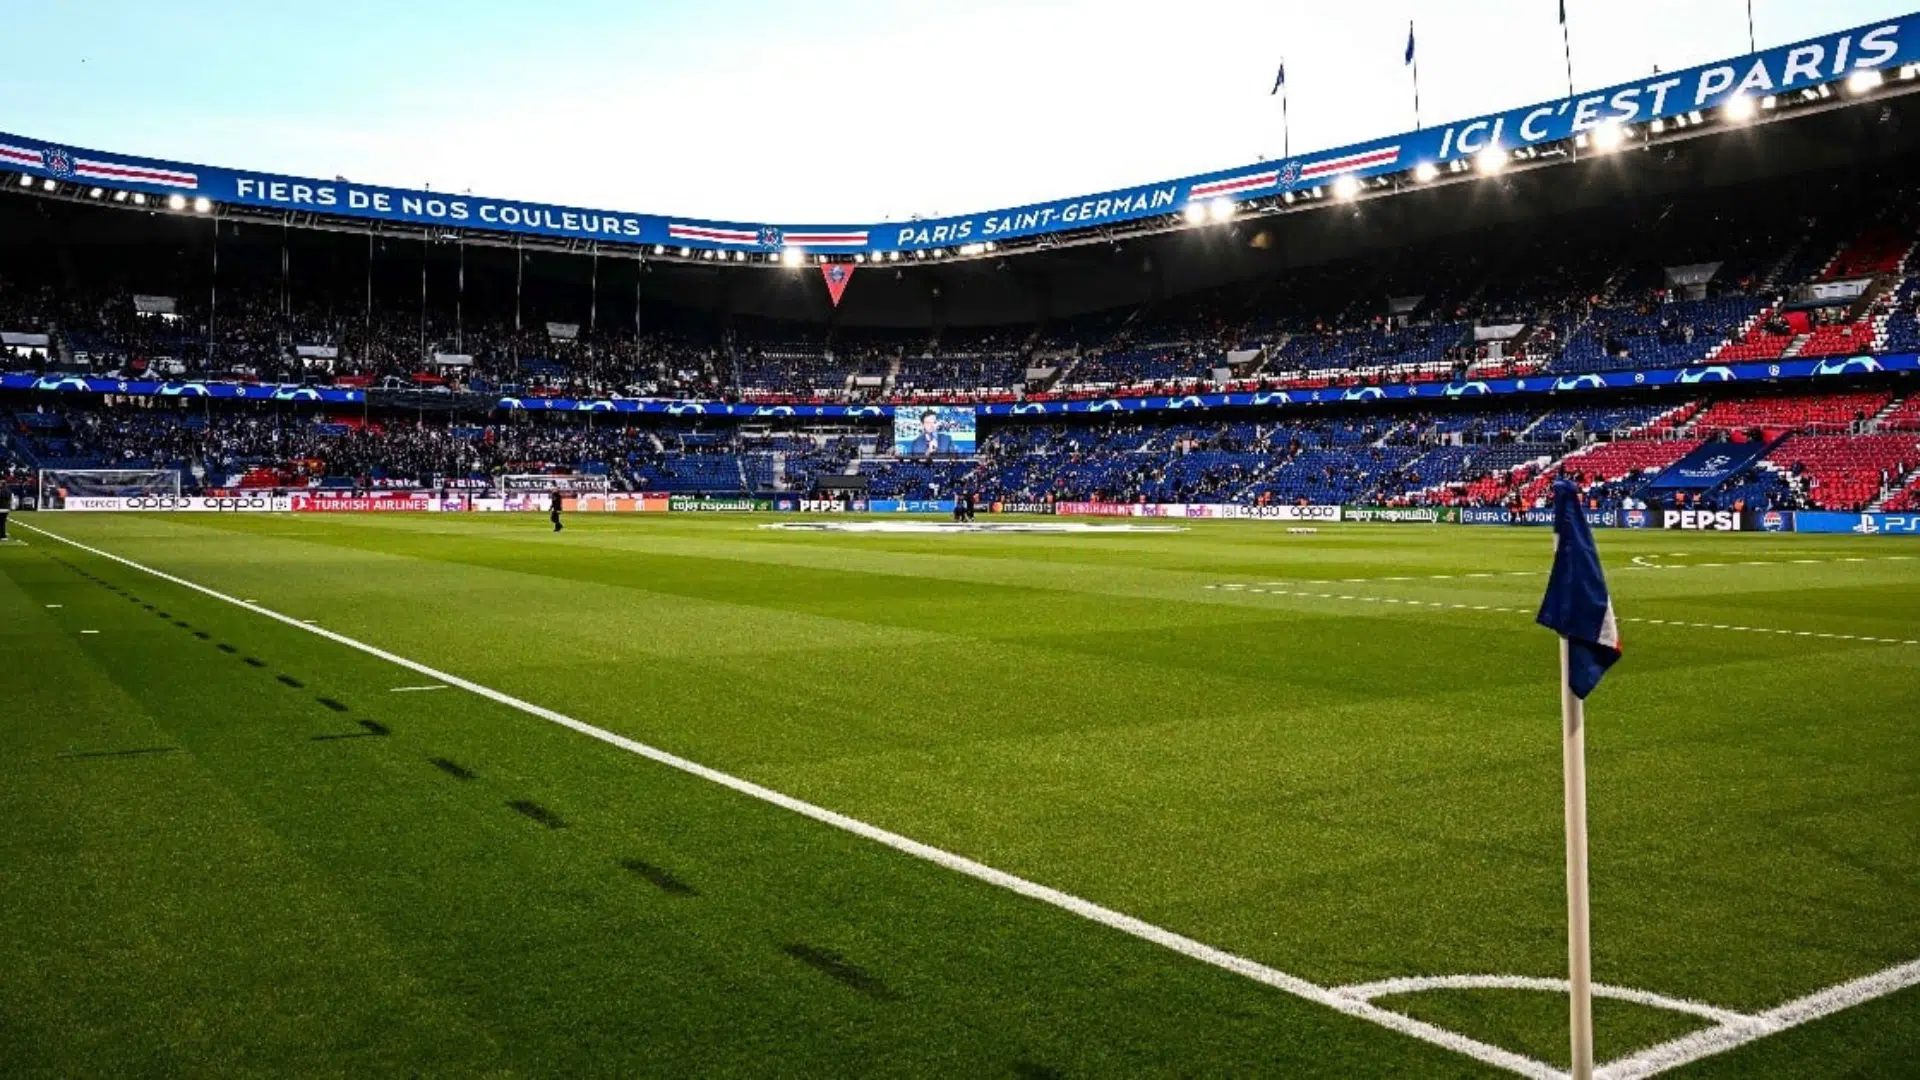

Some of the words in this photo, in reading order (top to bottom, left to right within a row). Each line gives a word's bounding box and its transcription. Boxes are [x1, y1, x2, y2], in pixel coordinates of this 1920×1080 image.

[1438, 117, 1504, 159] ICI
[1519, 77, 1681, 142] C'EST
[1694, 24, 1900, 106] PARIS
[236, 177, 337, 205] FIERS
[348, 189, 393, 212] DE
[402, 195, 469, 219] NOS
[479, 204, 641, 236] COULEURS
[897, 220, 972, 246] PARIS
[981, 186, 1177, 235] SAINT-GERMAIN
[203, 498, 265, 512] oppo
[314, 500, 370, 511] TURKISH
[373, 500, 429, 511] AIRLINES
[800, 500, 845, 513] PEPSI
[1290, 506, 1335, 520] oppo
[1475, 512, 1499, 522] UEFA
[1663, 510, 1741, 531] PEPSI
